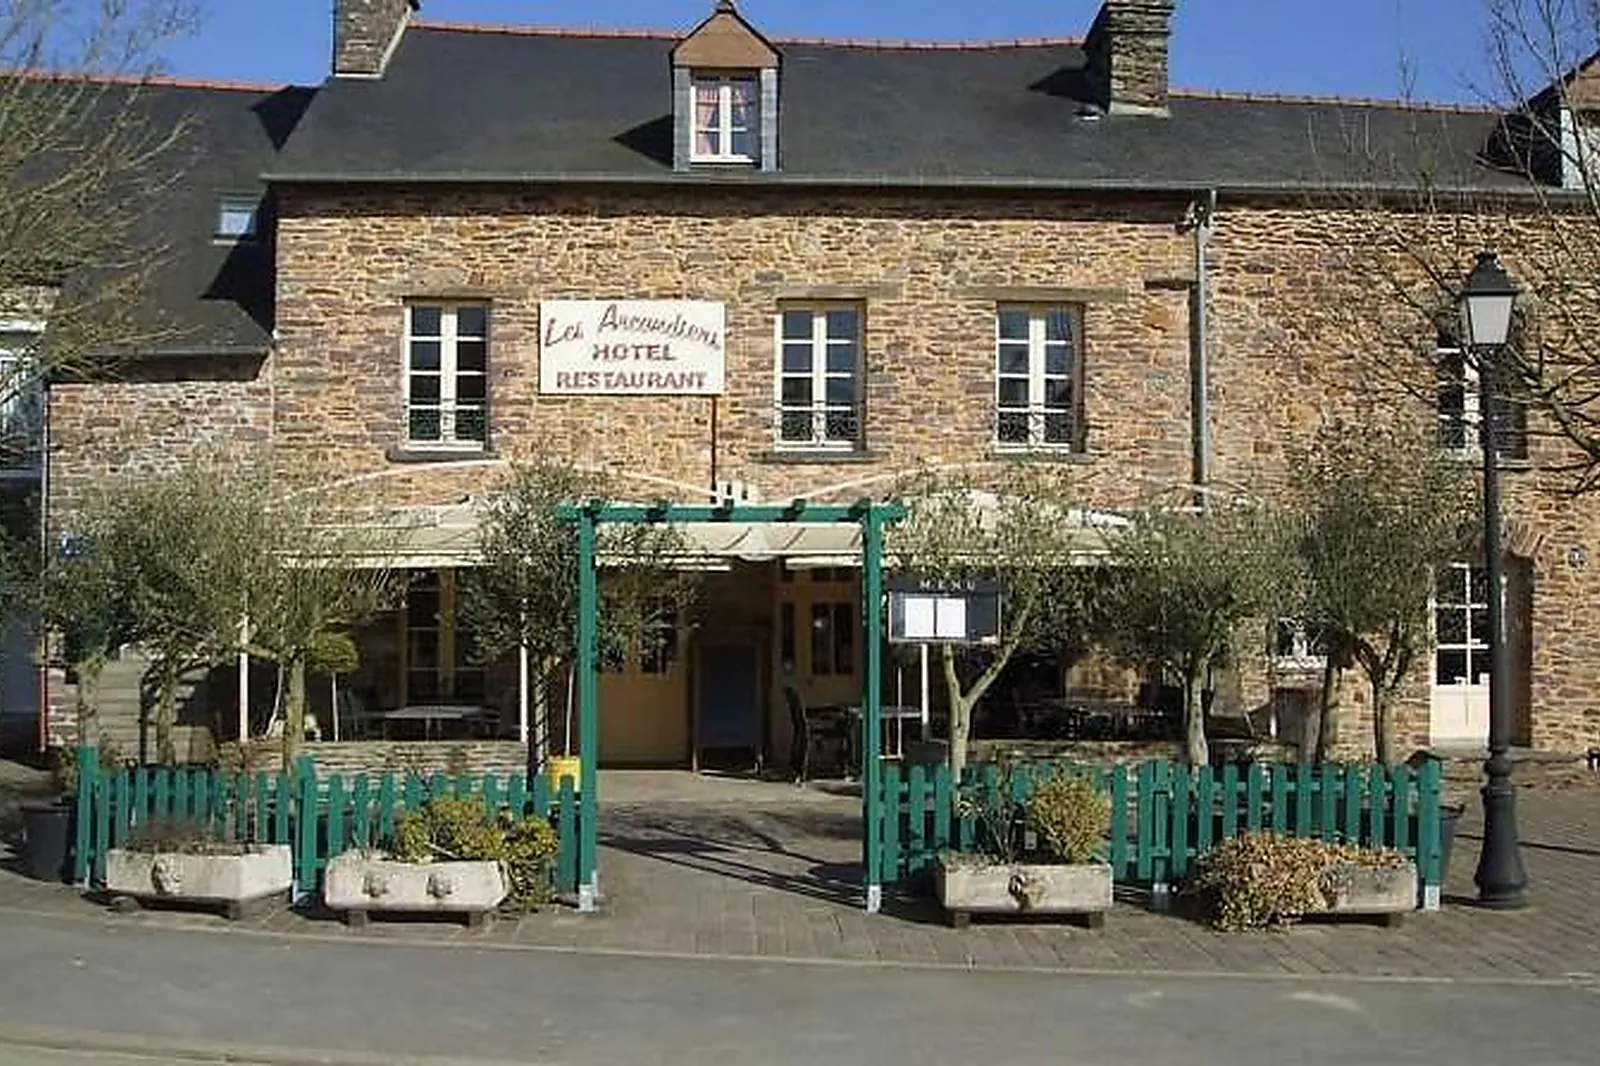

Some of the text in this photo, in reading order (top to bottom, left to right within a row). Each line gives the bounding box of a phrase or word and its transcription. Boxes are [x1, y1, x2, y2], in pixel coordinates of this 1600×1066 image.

[544, 317, 585, 347] Les
[592, 343, 677, 361] HOTEL
[556, 372, 708, 389] RESTAURANT
[920, 579, 976, 591] MENU
